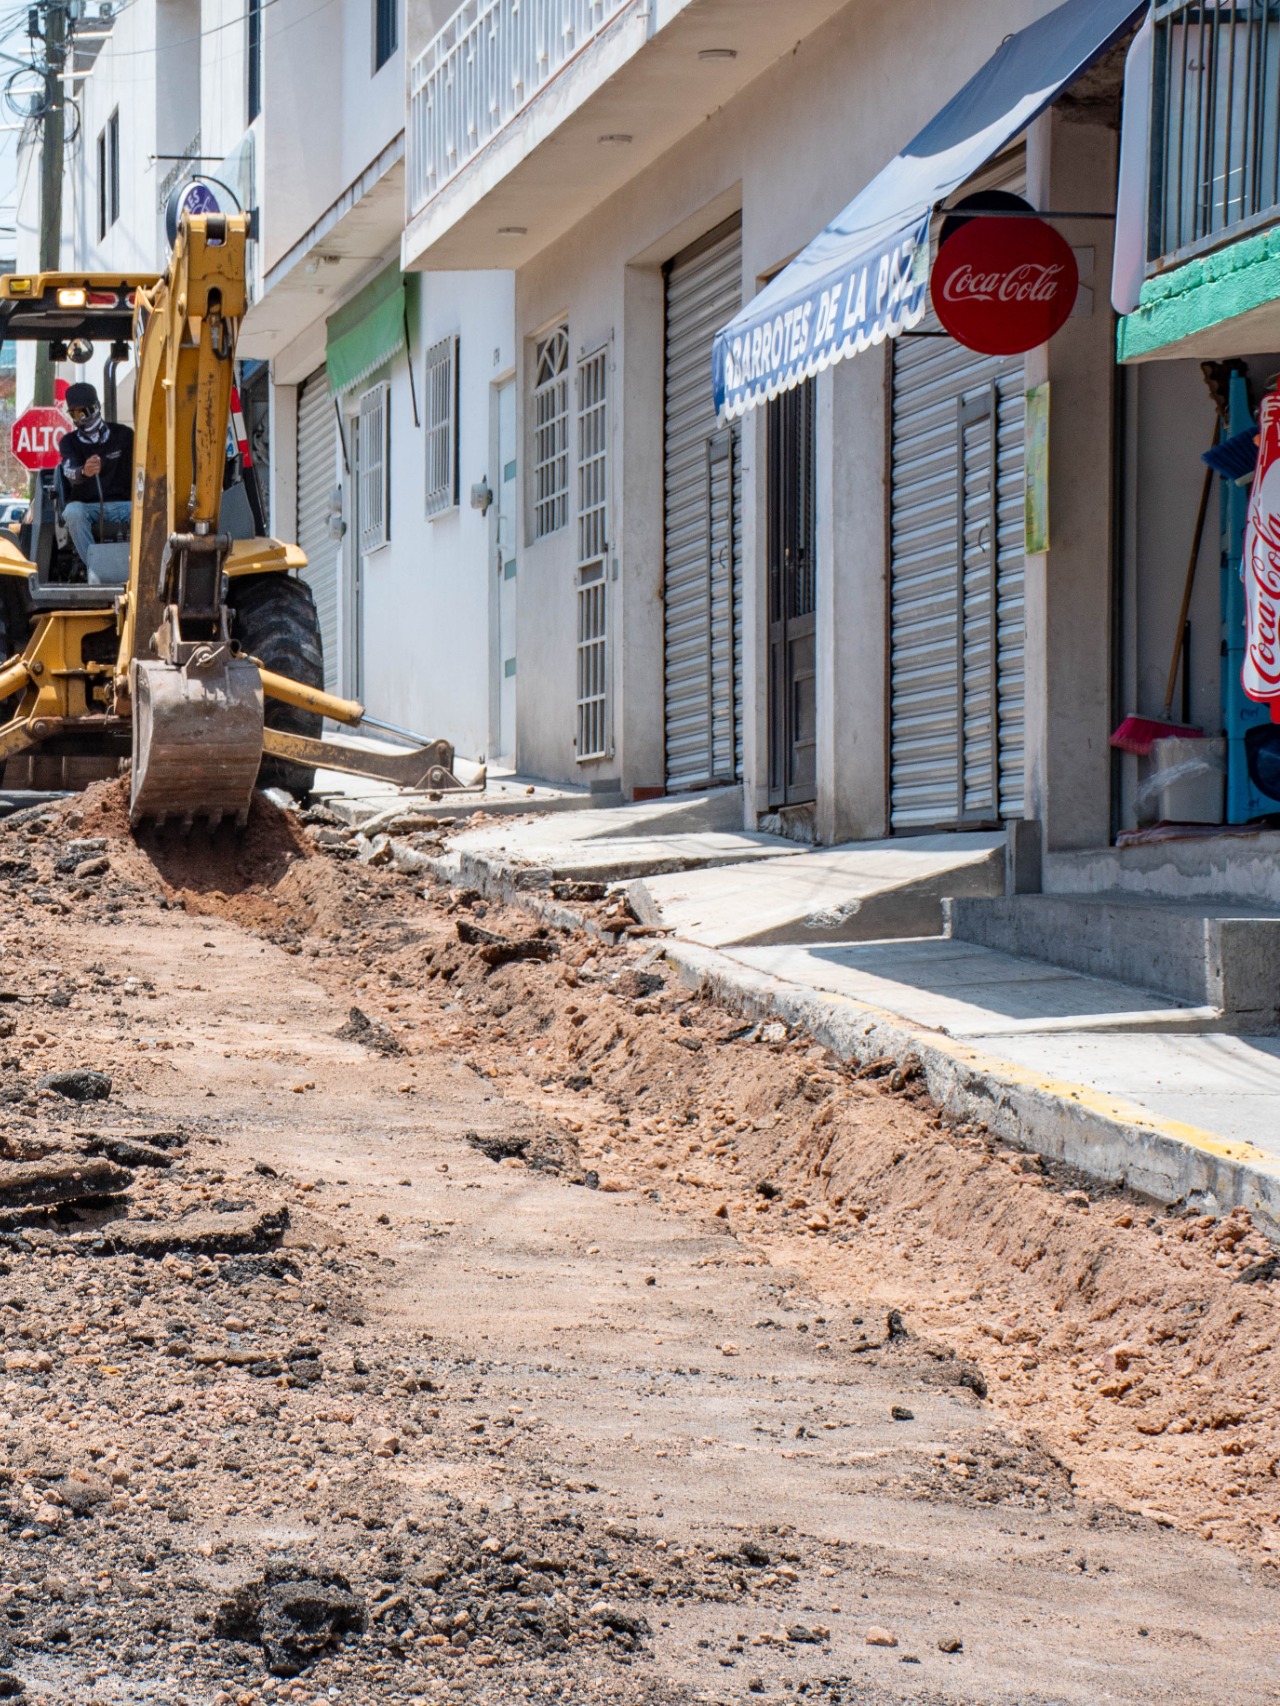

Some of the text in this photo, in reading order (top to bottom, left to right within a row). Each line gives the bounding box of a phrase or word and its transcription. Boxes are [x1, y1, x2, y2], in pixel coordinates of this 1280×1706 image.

[724, 236, 916, 391] ABARROTES DE LA PAZ
[943, 264, 1065, 302] Coca-Cola
